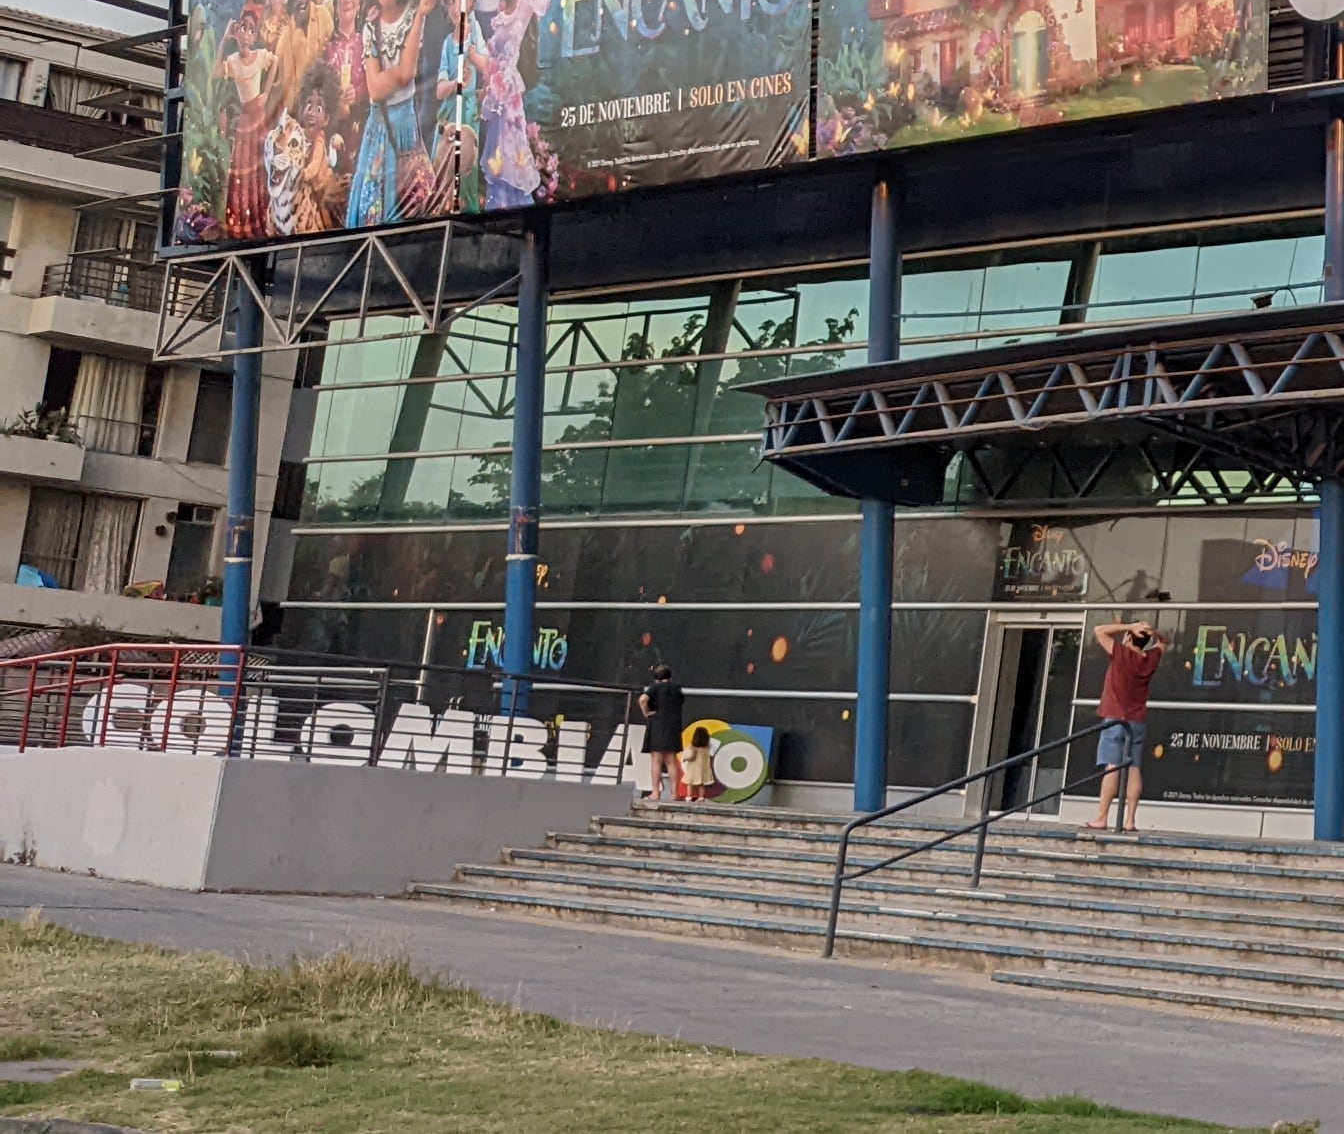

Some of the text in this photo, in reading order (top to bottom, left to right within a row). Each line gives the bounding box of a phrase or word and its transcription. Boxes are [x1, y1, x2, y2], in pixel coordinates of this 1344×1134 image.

[561, 107, 576, 128] 25
[579, 103, 595, 124] DE
[599, 91, 671, 121] NOVIEMBRE
[689, 86, 723, 108] SOLO
[728, 79, 748, 102] EN
[750, 72, 792, 99] CINES
[1003, 546, 1085, 579] ENCANTO
[1253, 539, 1318, 579] Disney
[83, 684, 664, 791] COLOMBIA
[1170, 732, 1184, 748] 25
[1186, 733, 1200, 749] DE
[1201, 733, 1261, 751] NOVIEMBRE
[1276, 736, 1302, 752] SOLO
